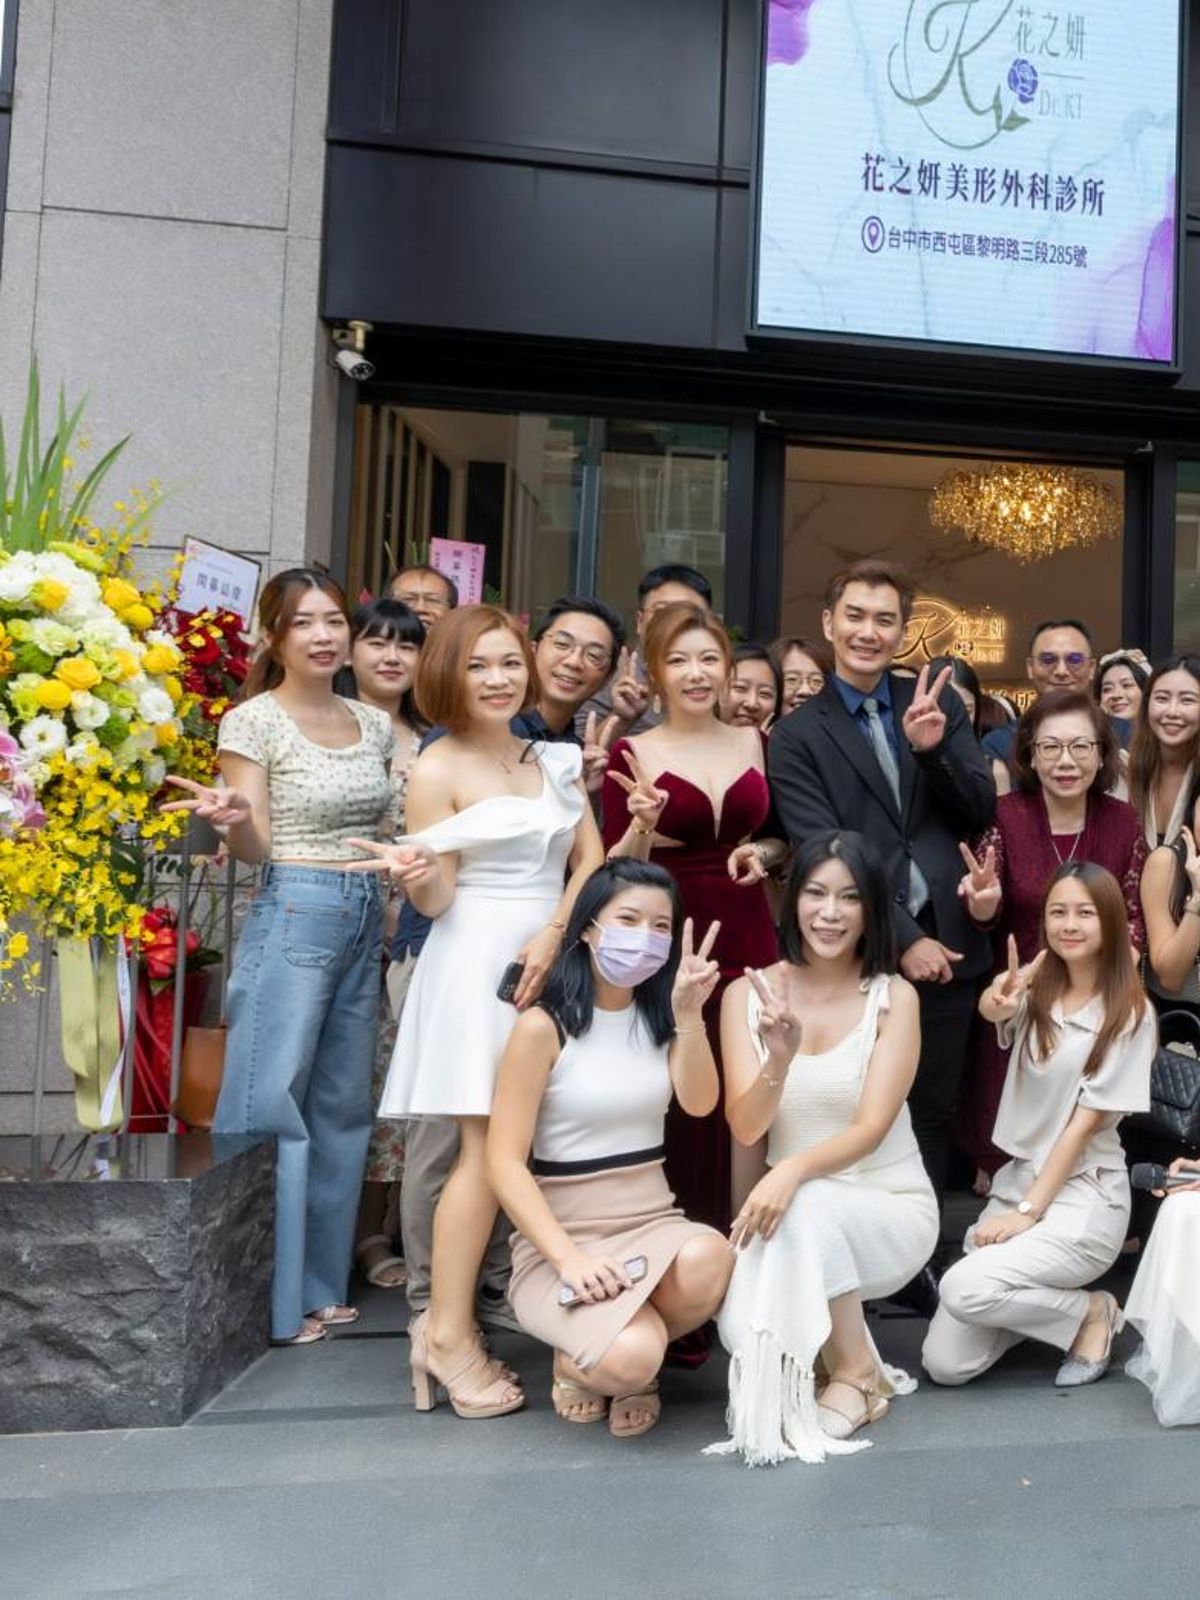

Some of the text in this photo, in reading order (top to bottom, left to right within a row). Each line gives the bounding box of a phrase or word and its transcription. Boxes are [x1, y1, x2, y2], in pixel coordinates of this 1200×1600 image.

[1015, 5, 1086, 61] 花之妍
[861, 152, 1105, 217] 花之妍美形外科診所
[887, 226, 1088, 268] 台中市西屯區黎明路三段285號
